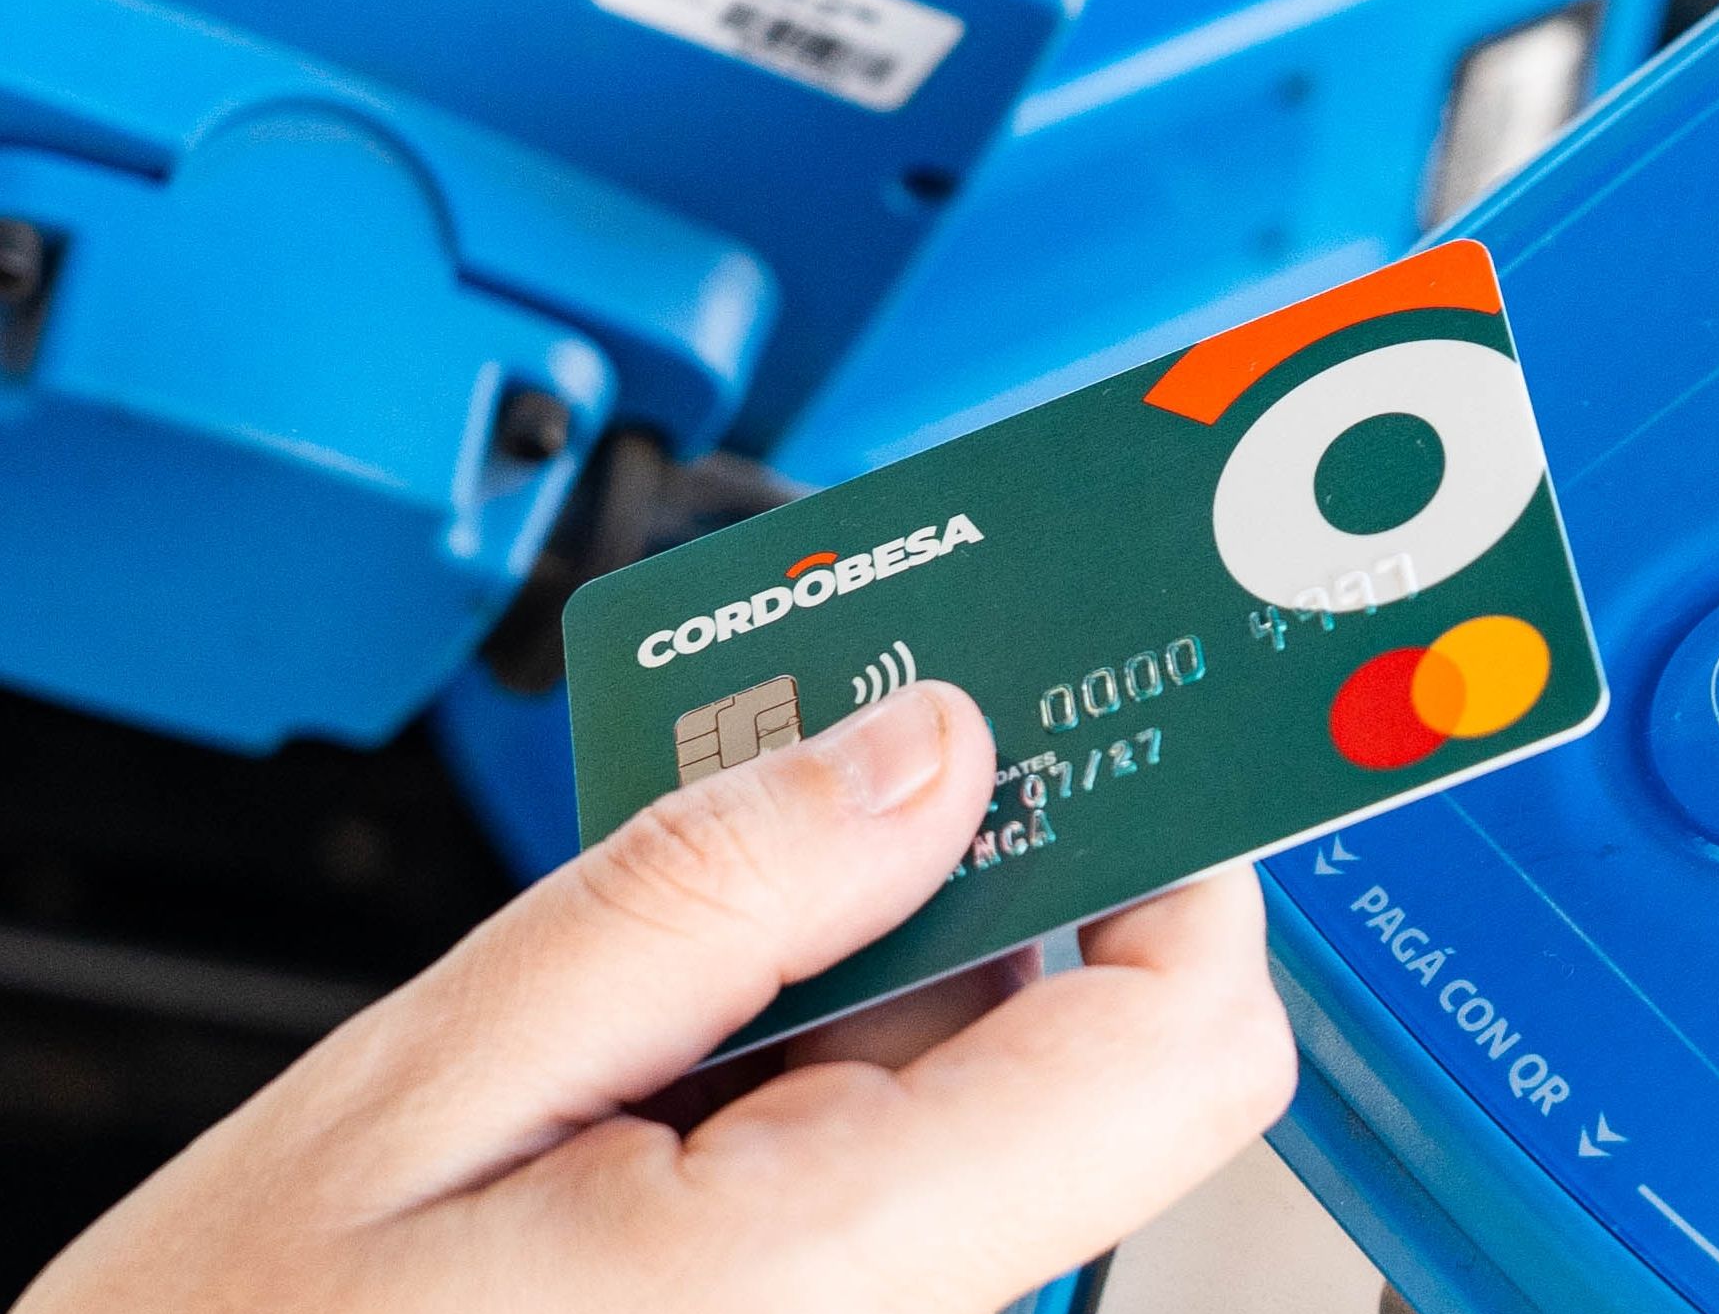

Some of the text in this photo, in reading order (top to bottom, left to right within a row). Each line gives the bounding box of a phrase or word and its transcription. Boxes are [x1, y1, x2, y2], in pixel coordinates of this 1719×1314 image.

[1040, 634, 1206, 733] 0000
[1350, 885, 1570, 1117] PAGÁ CON QR
